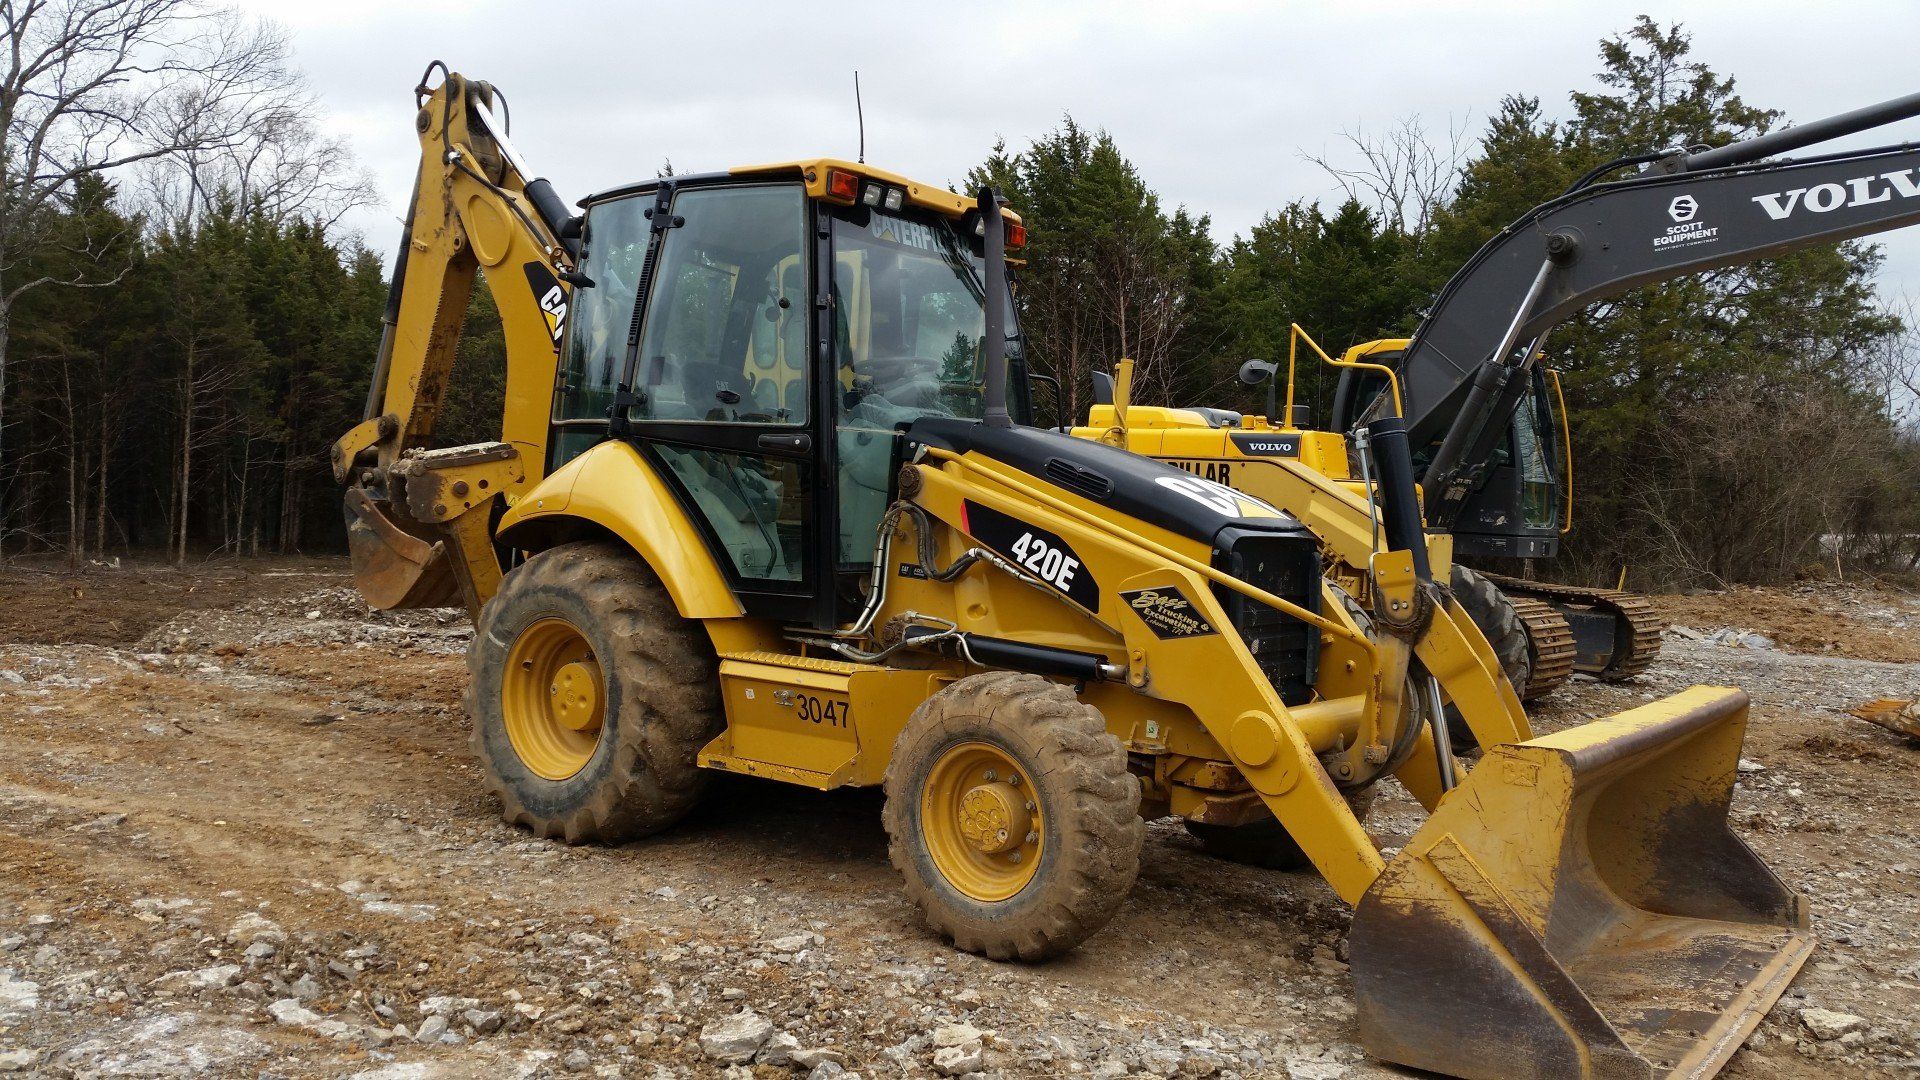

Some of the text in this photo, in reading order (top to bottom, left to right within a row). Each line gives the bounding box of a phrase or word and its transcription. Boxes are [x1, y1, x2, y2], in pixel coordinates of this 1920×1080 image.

[1653, 227, 1719, 246] EQUIPMENT
[1666, 221, 1704, 235] SCOTT
[540, 285, 567, 341] CA
[1248, 442, 1292, 452] VOLVO
[1011, 532, 1080, 592] 420E
[1131, 591, 1188, 609] Bass
[1143, 607, 1193, 634] Excavating
[1157, 605, 1210, 632] Trucking &
[796, 693, 850, 728] 3047
